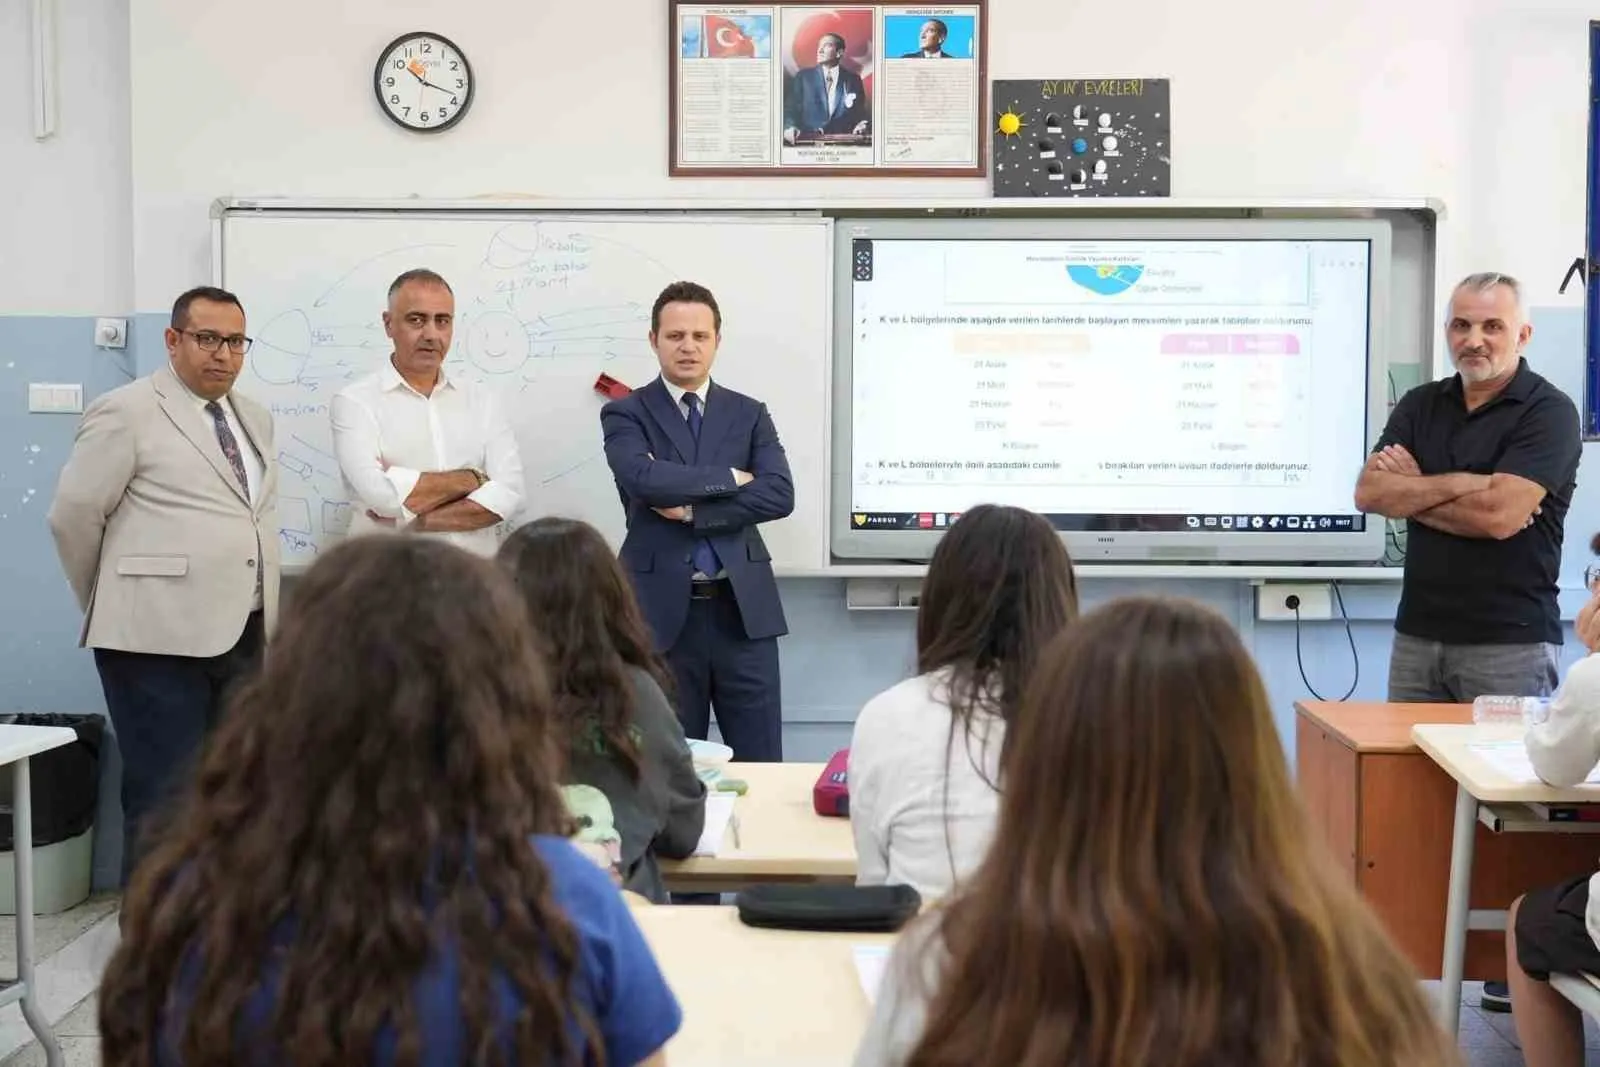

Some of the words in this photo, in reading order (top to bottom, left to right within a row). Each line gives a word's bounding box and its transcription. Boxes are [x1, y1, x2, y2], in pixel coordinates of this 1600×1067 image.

[404, 48, 412, 58] 11
[420, 43, 432, 56] 12
[393, 59, 406, 70] 10
[450, 61, 458, 71] 2
[385, 77, 395, 87] 9
[456, 79, 464, 89] 3
[391, 95, 400, 104] 8
[450, 96, 458, 106] 4
[401, 106, 411, 117] 7
[439, 107, 447, 117] 5
[420, 112, 429, 122] 6
[879, 316, 886, 324] K
[878, 460, 885, 469] K
